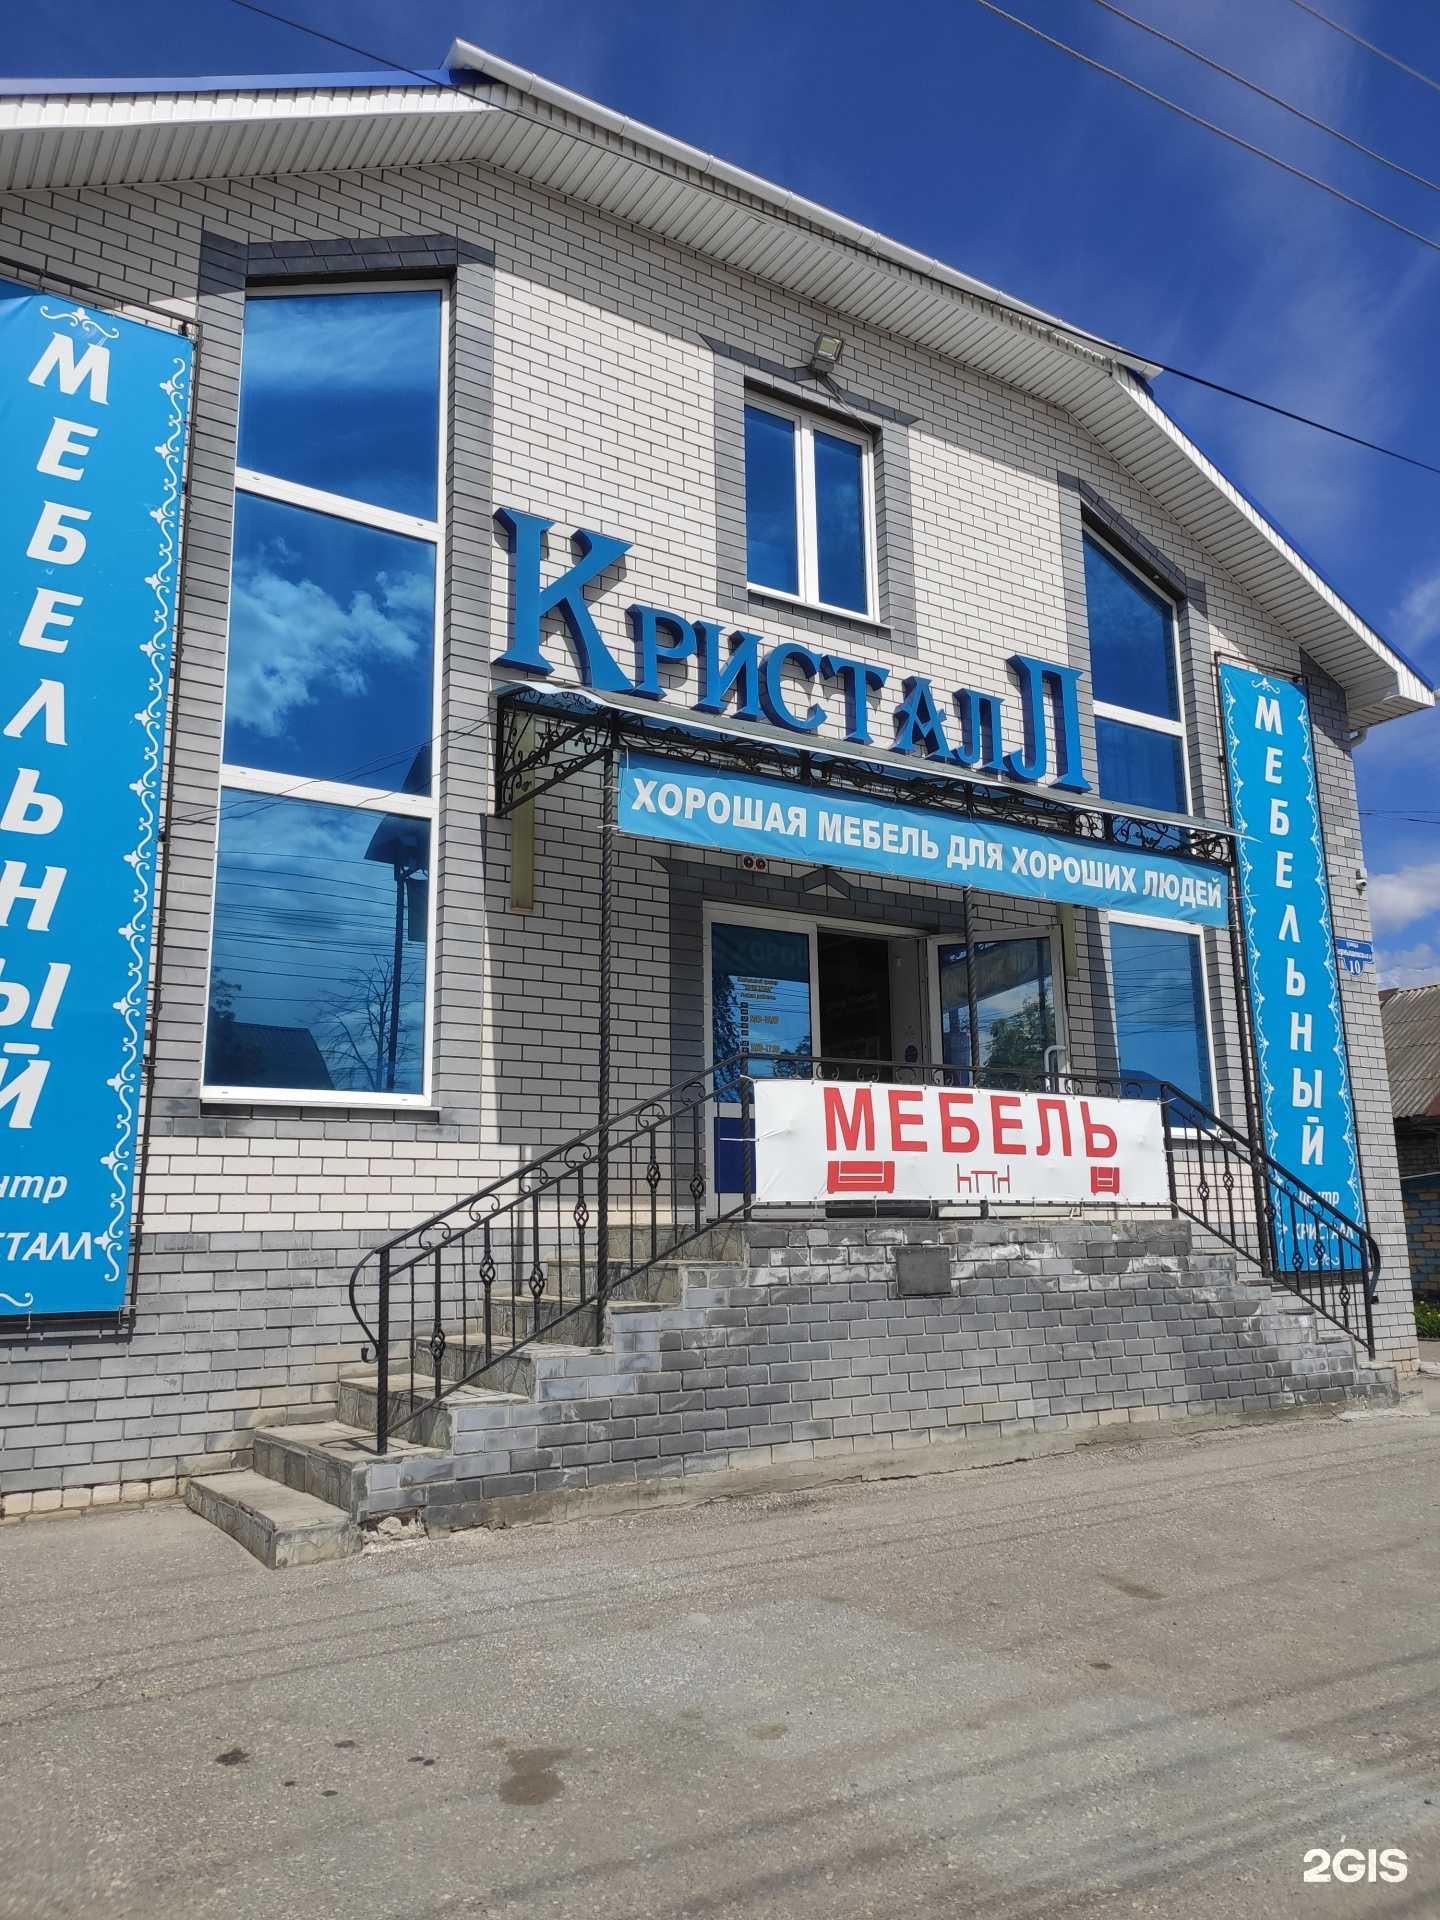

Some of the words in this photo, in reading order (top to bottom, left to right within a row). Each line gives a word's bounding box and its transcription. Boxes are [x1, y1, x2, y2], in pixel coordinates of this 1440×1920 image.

[631, 777, 807, 838] ХОРОШАЯ
[818, 810, 940, 860] МЕБЕЛЬ
[946, 834, 1004, 872] ДЛЯ
[1011, 845, 1137, 893] ХОРОШИХ
[1142, 869, 1222, 909] ЛЮДЕЙ
[1254, 695, 1325, 1166] МЕБЕЛЬНЫЙ
[1350, 959, 1361, 974] 10
[823, 1086, 1119, 1159] МЕБЕЛЬ
